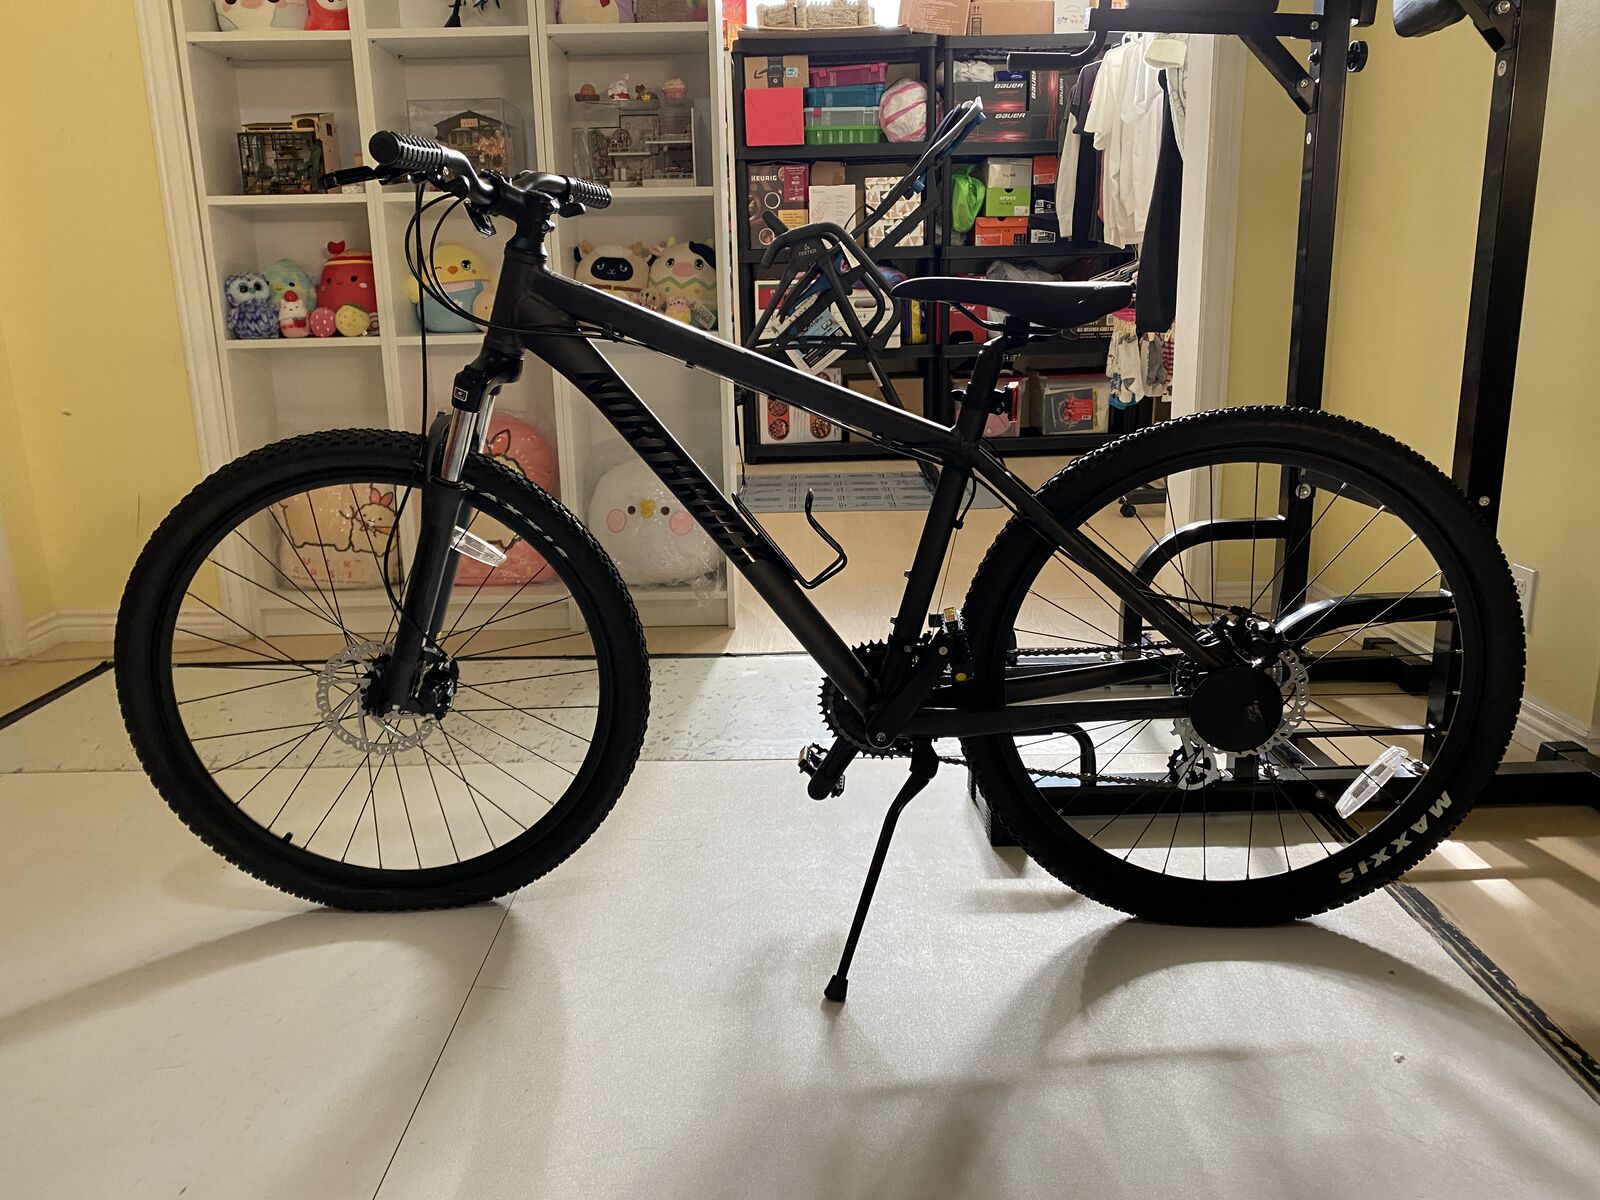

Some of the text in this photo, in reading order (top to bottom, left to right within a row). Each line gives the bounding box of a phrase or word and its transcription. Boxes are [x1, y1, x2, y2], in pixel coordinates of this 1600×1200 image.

[798, 248, 817, 257] TEETER
[575, 372, 766, 566] NORTHROCK
[1338, 790, 1452, 885] MAXXIS
